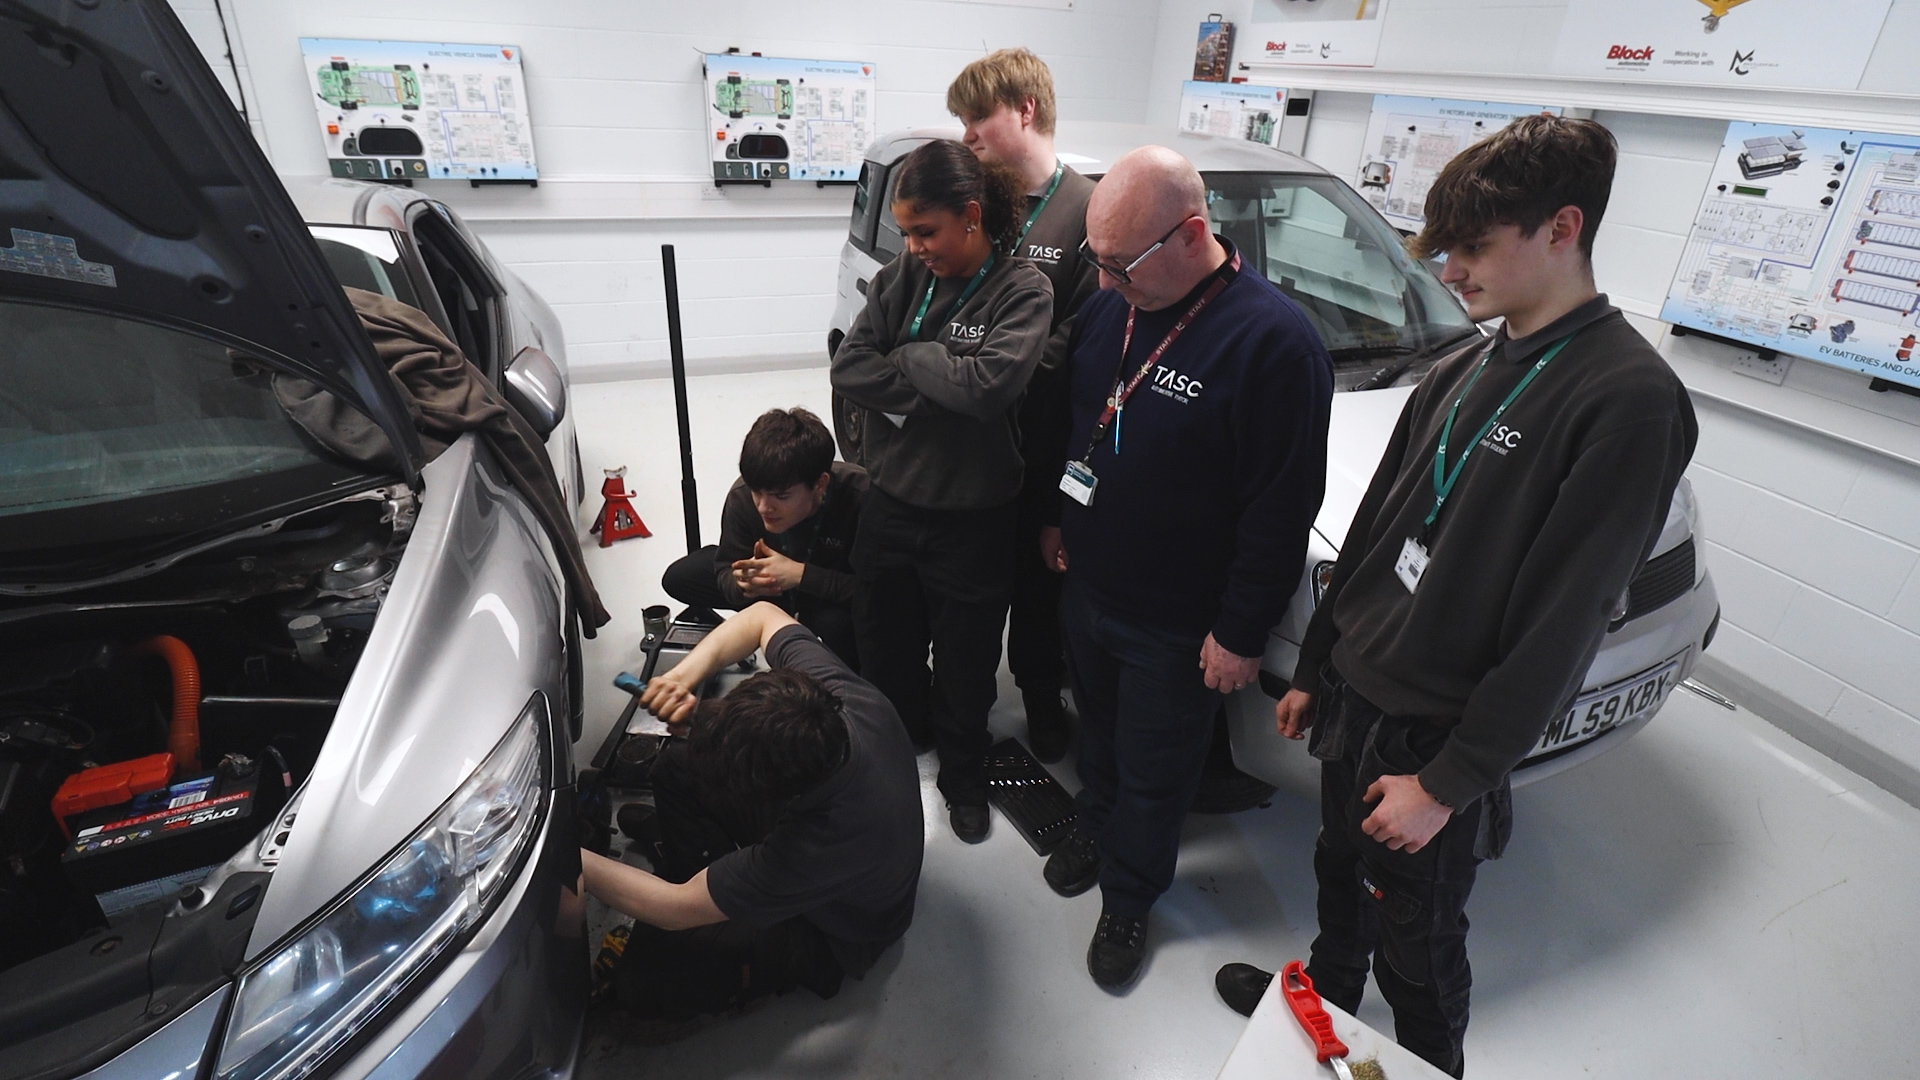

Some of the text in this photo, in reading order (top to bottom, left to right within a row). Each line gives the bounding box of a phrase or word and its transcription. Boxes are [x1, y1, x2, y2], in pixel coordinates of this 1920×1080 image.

[1265, 41, 1287, 51] Block
[1607, 45, 1655, 61] Block
[1477, 111, 1509, 119] GENERATORS
[1028, 244, 1063, 260] TASC
[951, 322, 986, 338] TASC
[1155, 335, 1172, 356] STAFF
[1819, 345, 1833, 354] EV
[1833, 349, 1880, 367] BATTERIES
[1880, 361, 1903, 373] AND
[1154, 365, 1204, 398] TASC
[1541, 671, 1671, 749] ML59 KBX
